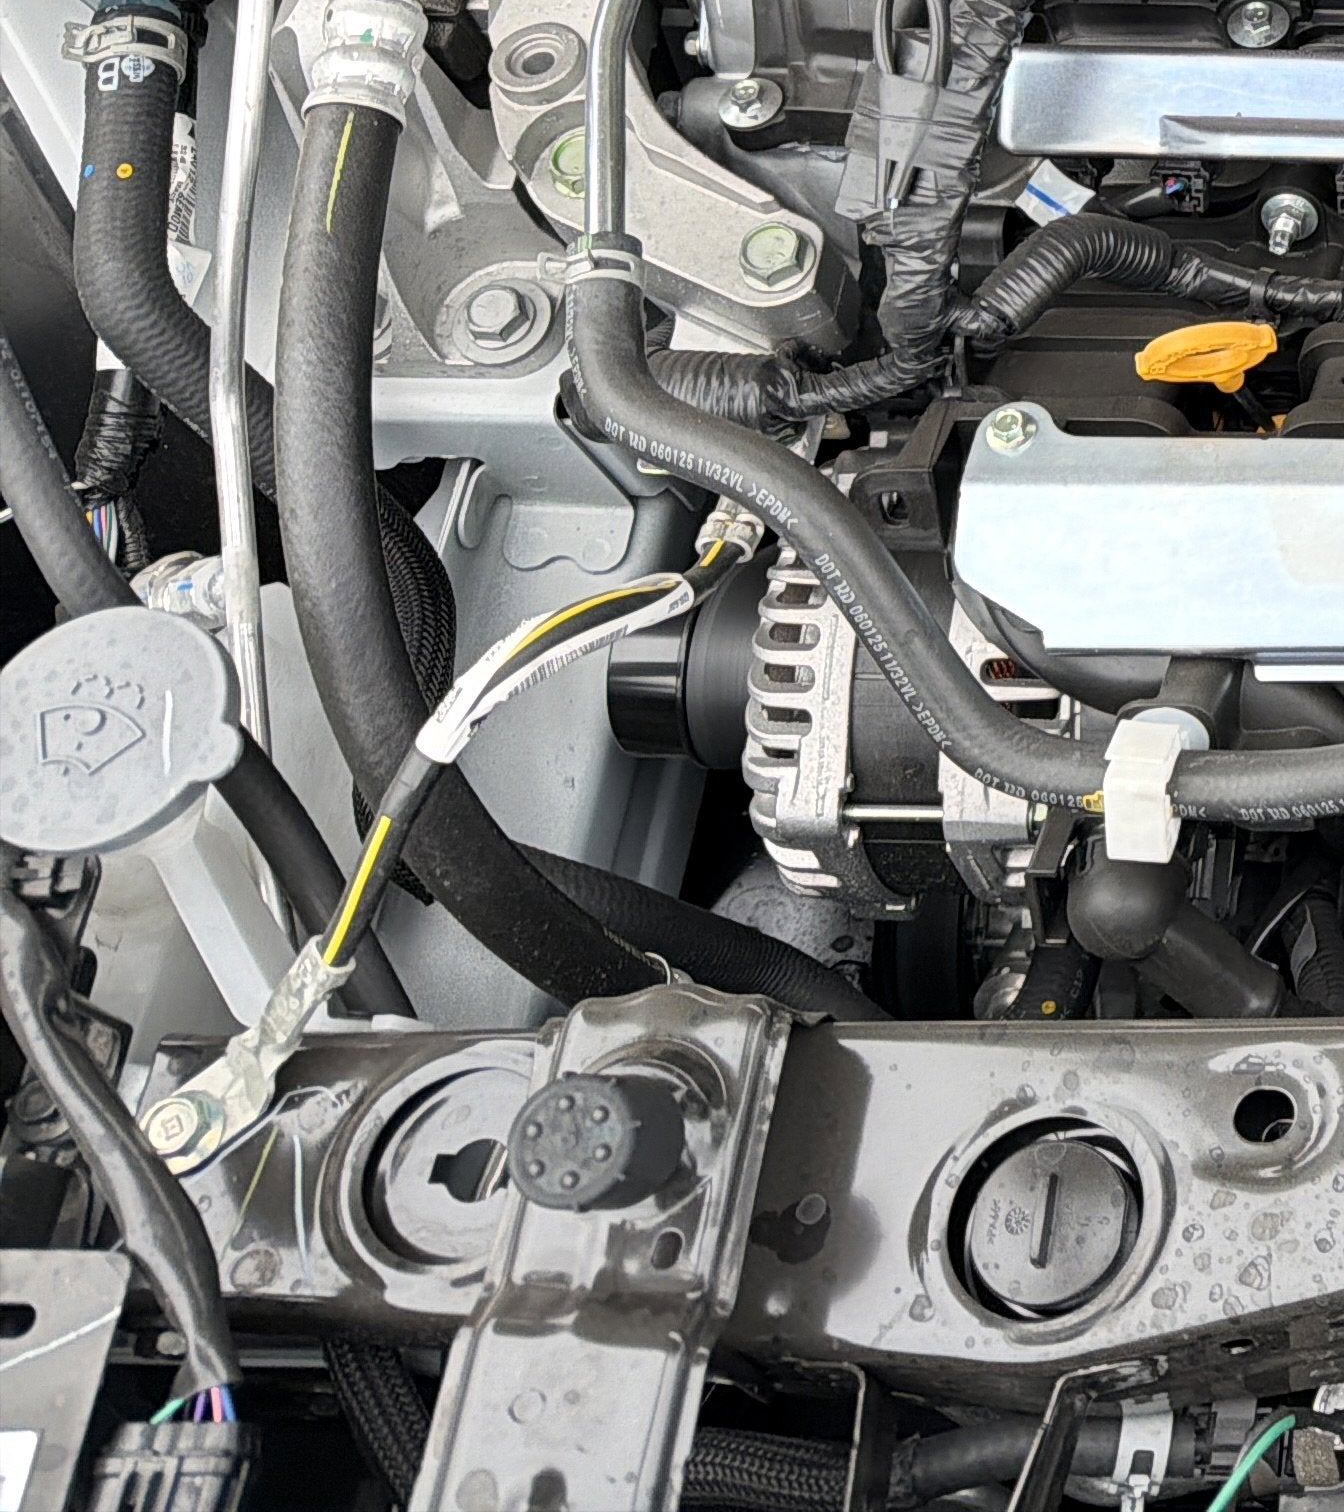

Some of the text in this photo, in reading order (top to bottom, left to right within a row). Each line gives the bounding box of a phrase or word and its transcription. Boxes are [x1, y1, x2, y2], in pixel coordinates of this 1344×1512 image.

[604, 416, 626, 443] DOT
[650, 444, 695, 470] 060125
[815, 553, 841, 580] DOT
[849, 605, 889, 653] 060125
